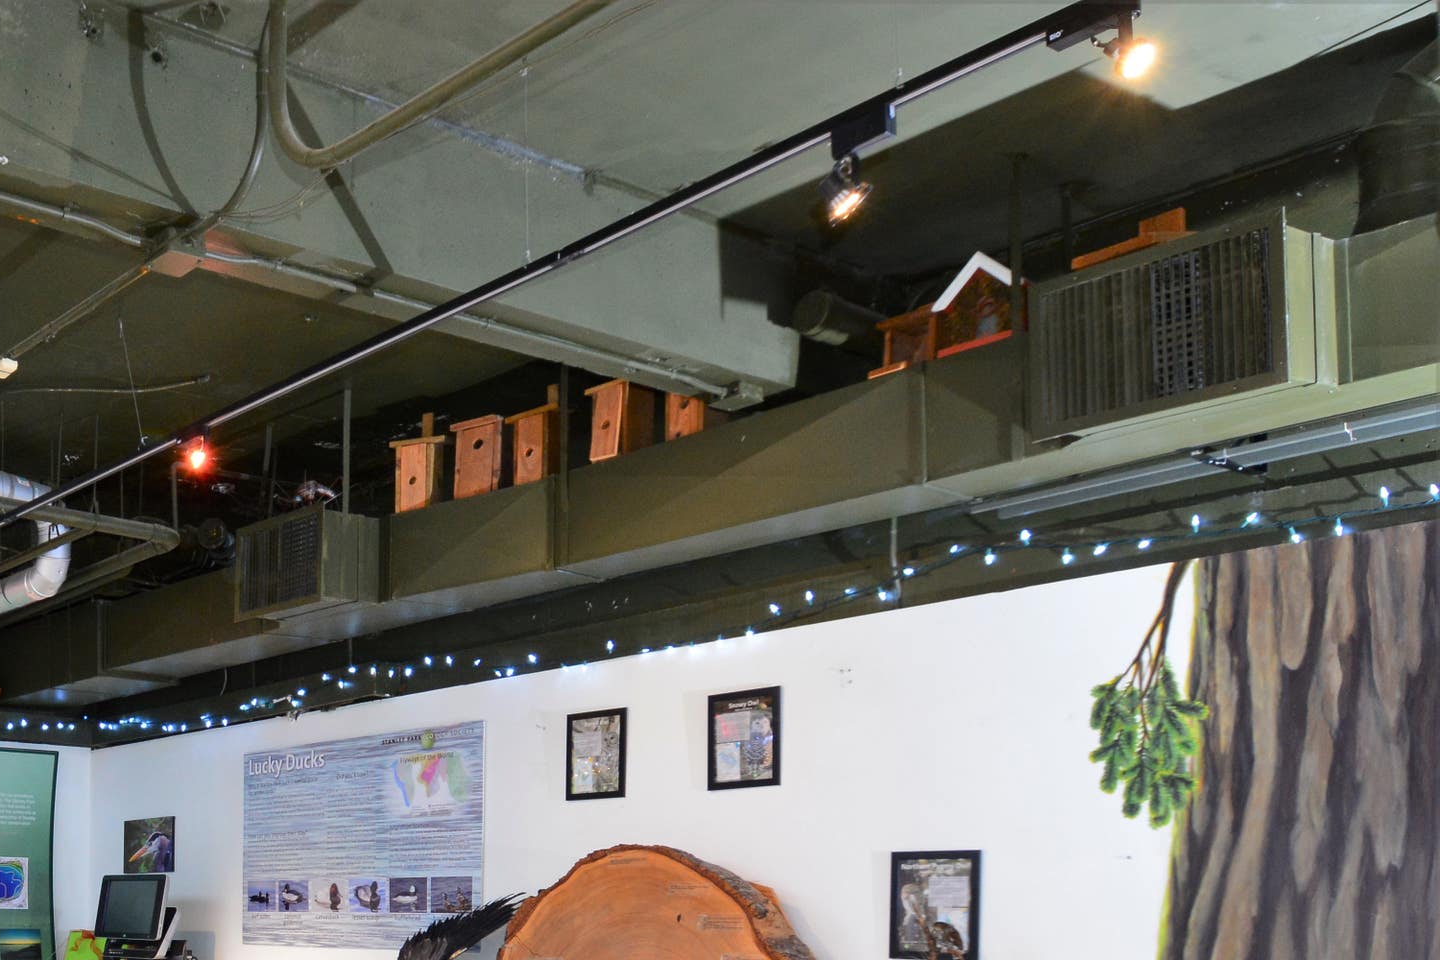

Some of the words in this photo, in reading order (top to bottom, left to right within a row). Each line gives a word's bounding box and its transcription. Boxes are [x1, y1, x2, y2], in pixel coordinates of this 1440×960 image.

[728, 701, 747, 709] Snowy
[747, 699, 760, 707] Owl
[249, 755, 283, 778] Lucky
[286, 749, 325, 771] Ducks
